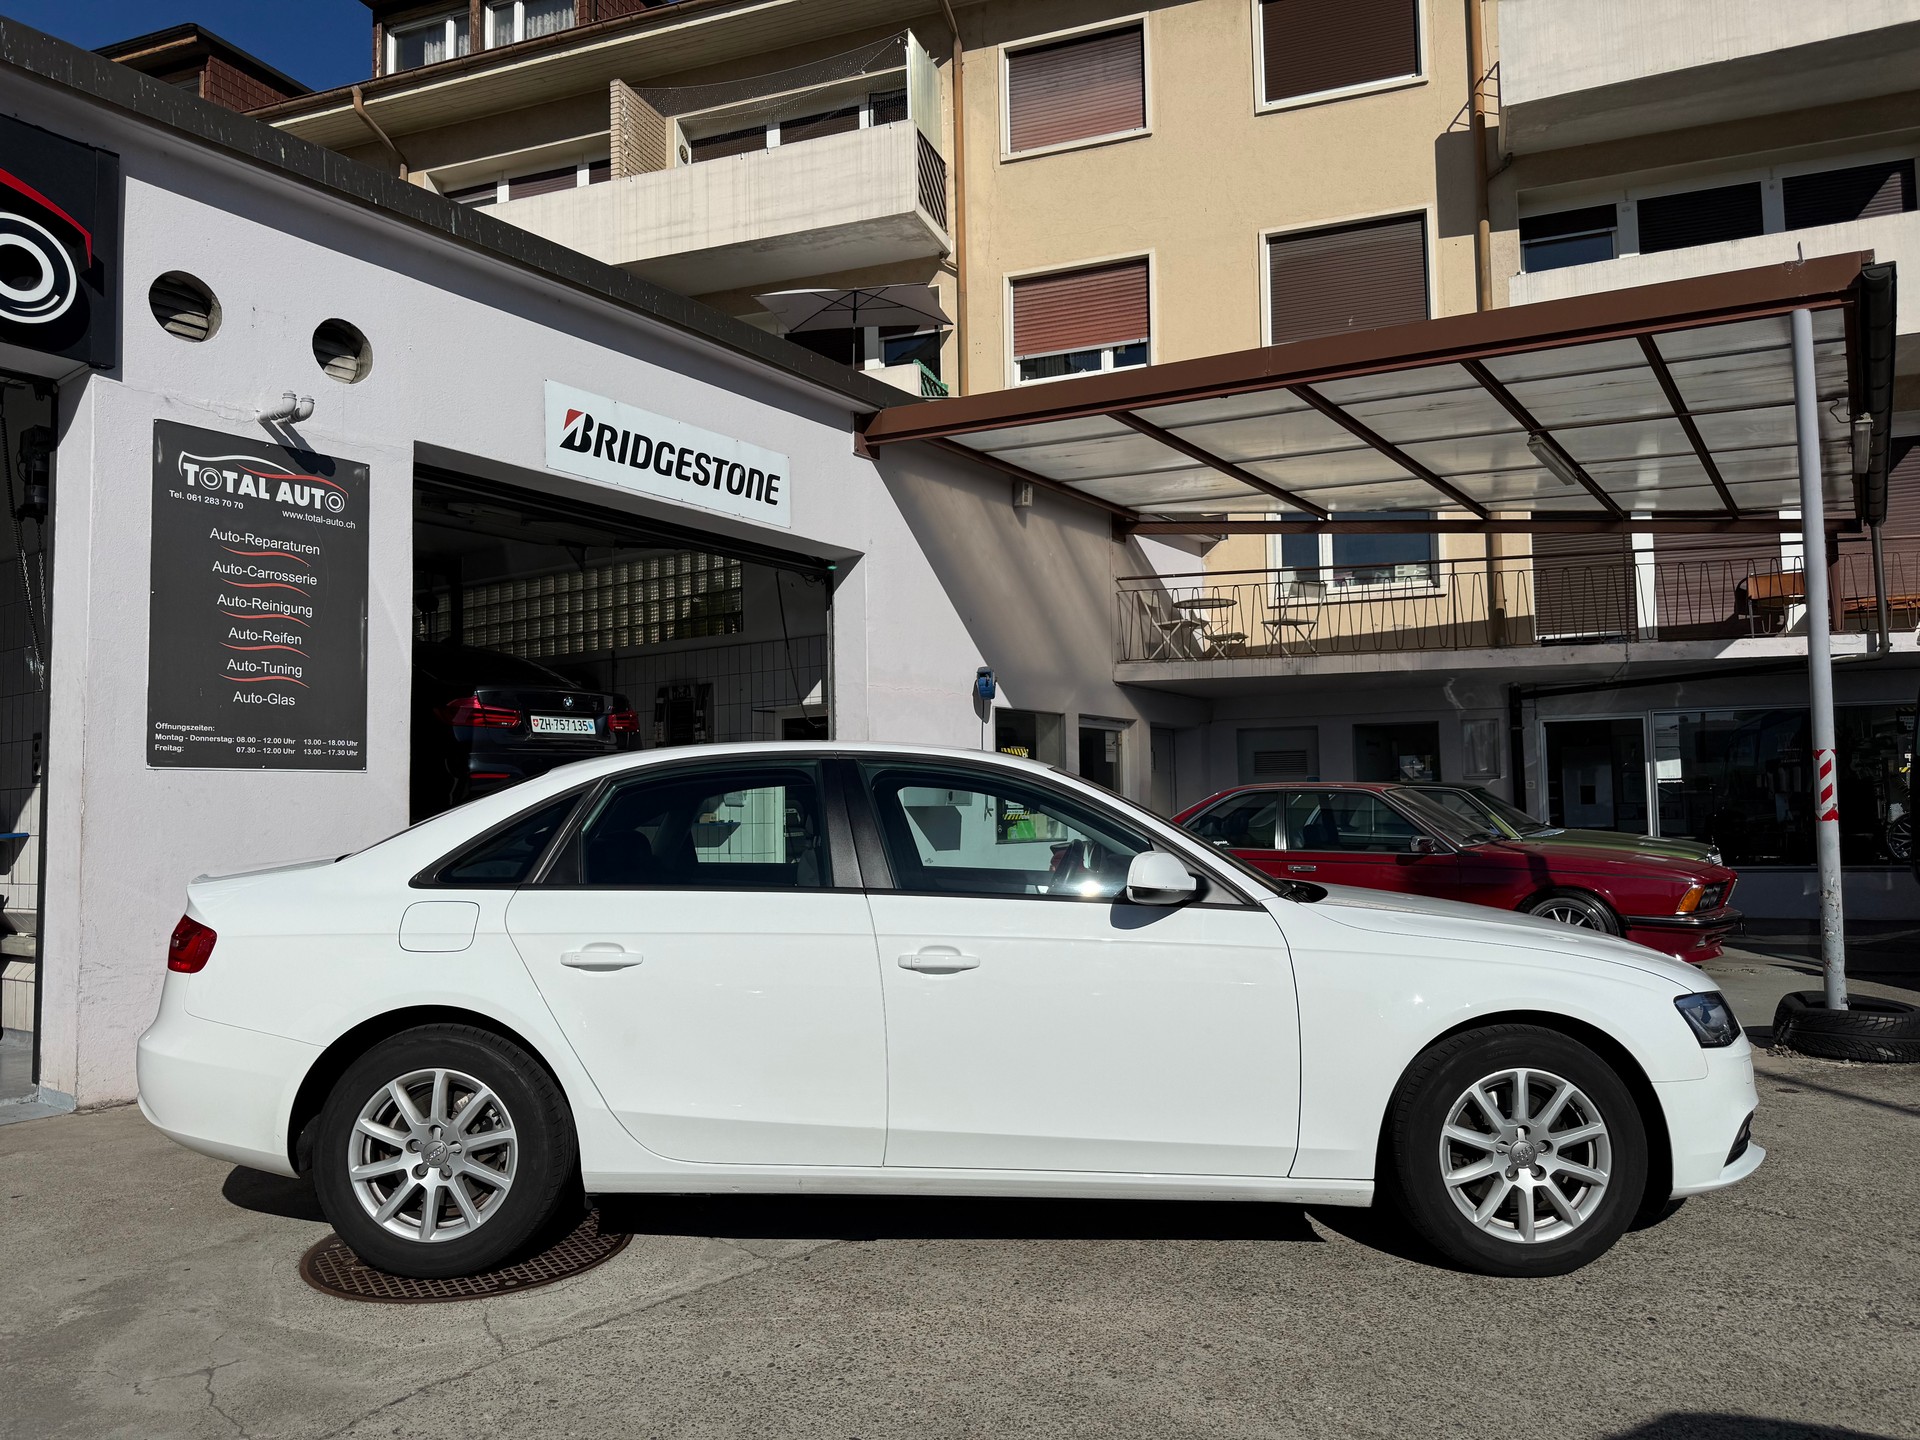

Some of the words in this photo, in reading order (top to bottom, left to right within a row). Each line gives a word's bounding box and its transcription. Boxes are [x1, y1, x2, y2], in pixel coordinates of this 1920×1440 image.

[559, 408, 781, 506] BRIDGESTONE
[183, 462, 271, 500] TOTAL
[275, 482, 345, 513] AUTO
[169, 489, 185, 500] Tel.
[186, 492, 202, 503] 061
[204, 496, 220, 506] 283
[222, 499, 232, 508] 70
[233, 501, 244, 510] 70
[282, 509, 356, 530] www.total-auto.ch
[209, 527, 320, 555] Auto-Reparaturen
[212, 560, 318, 586] Auto-Carrosserie
[216, 593, 313, 618] Auto-Reinigung
[228, 626, 302, 645] Auto-Reifen
[226, 658, 303, 678] Auto-Tuning
[232, 690, 296, 706] Auto-Glas
[154, 744, 185, 753] Freitag:
[236, 746, 256, 754] 07.30
[155, 733, 184, 742] Montag
[189, 734, 235, 744] Donnerstag:
[303, 748, 322, 756] 13.00
